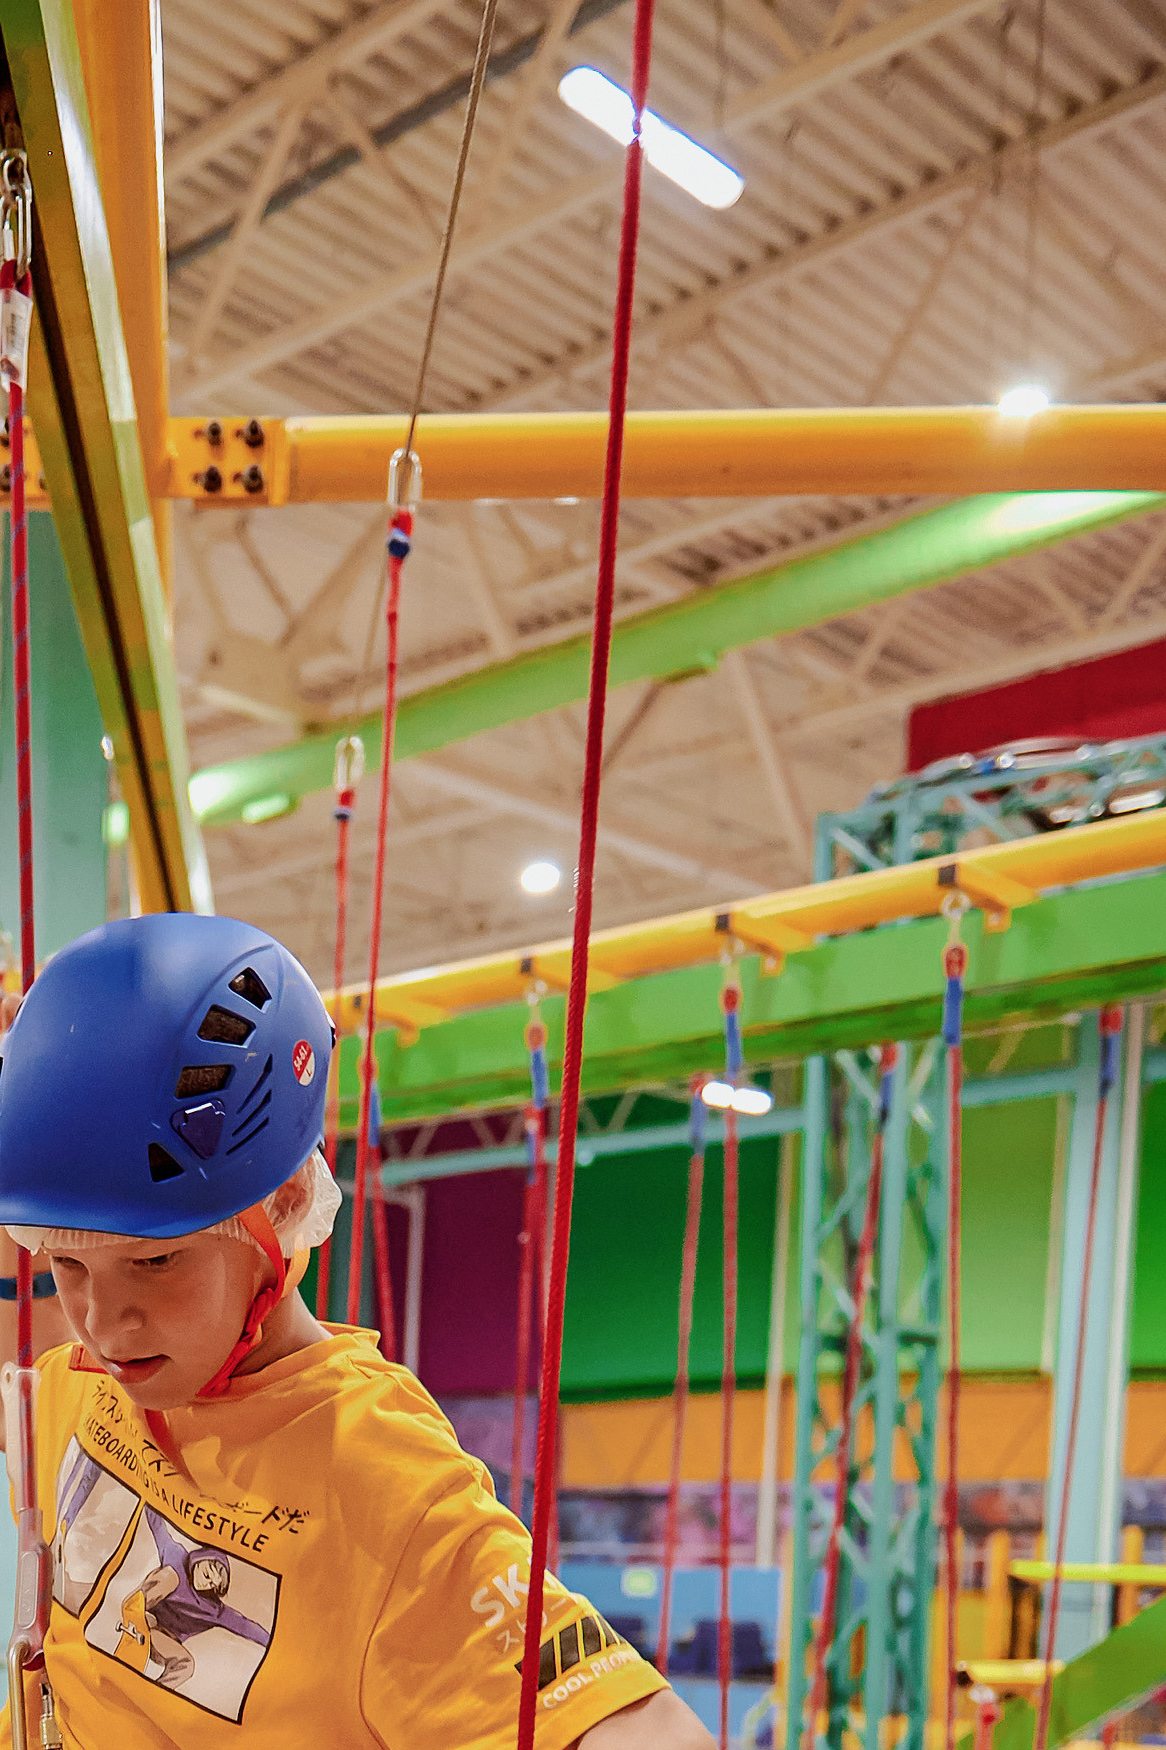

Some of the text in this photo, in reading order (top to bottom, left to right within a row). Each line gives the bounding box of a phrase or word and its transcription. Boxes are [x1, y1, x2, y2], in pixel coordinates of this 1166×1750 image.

[172, 1494, 269, 1552] LIFESTYLE
[542, 1650, 639, 1709] COOL PEOP
